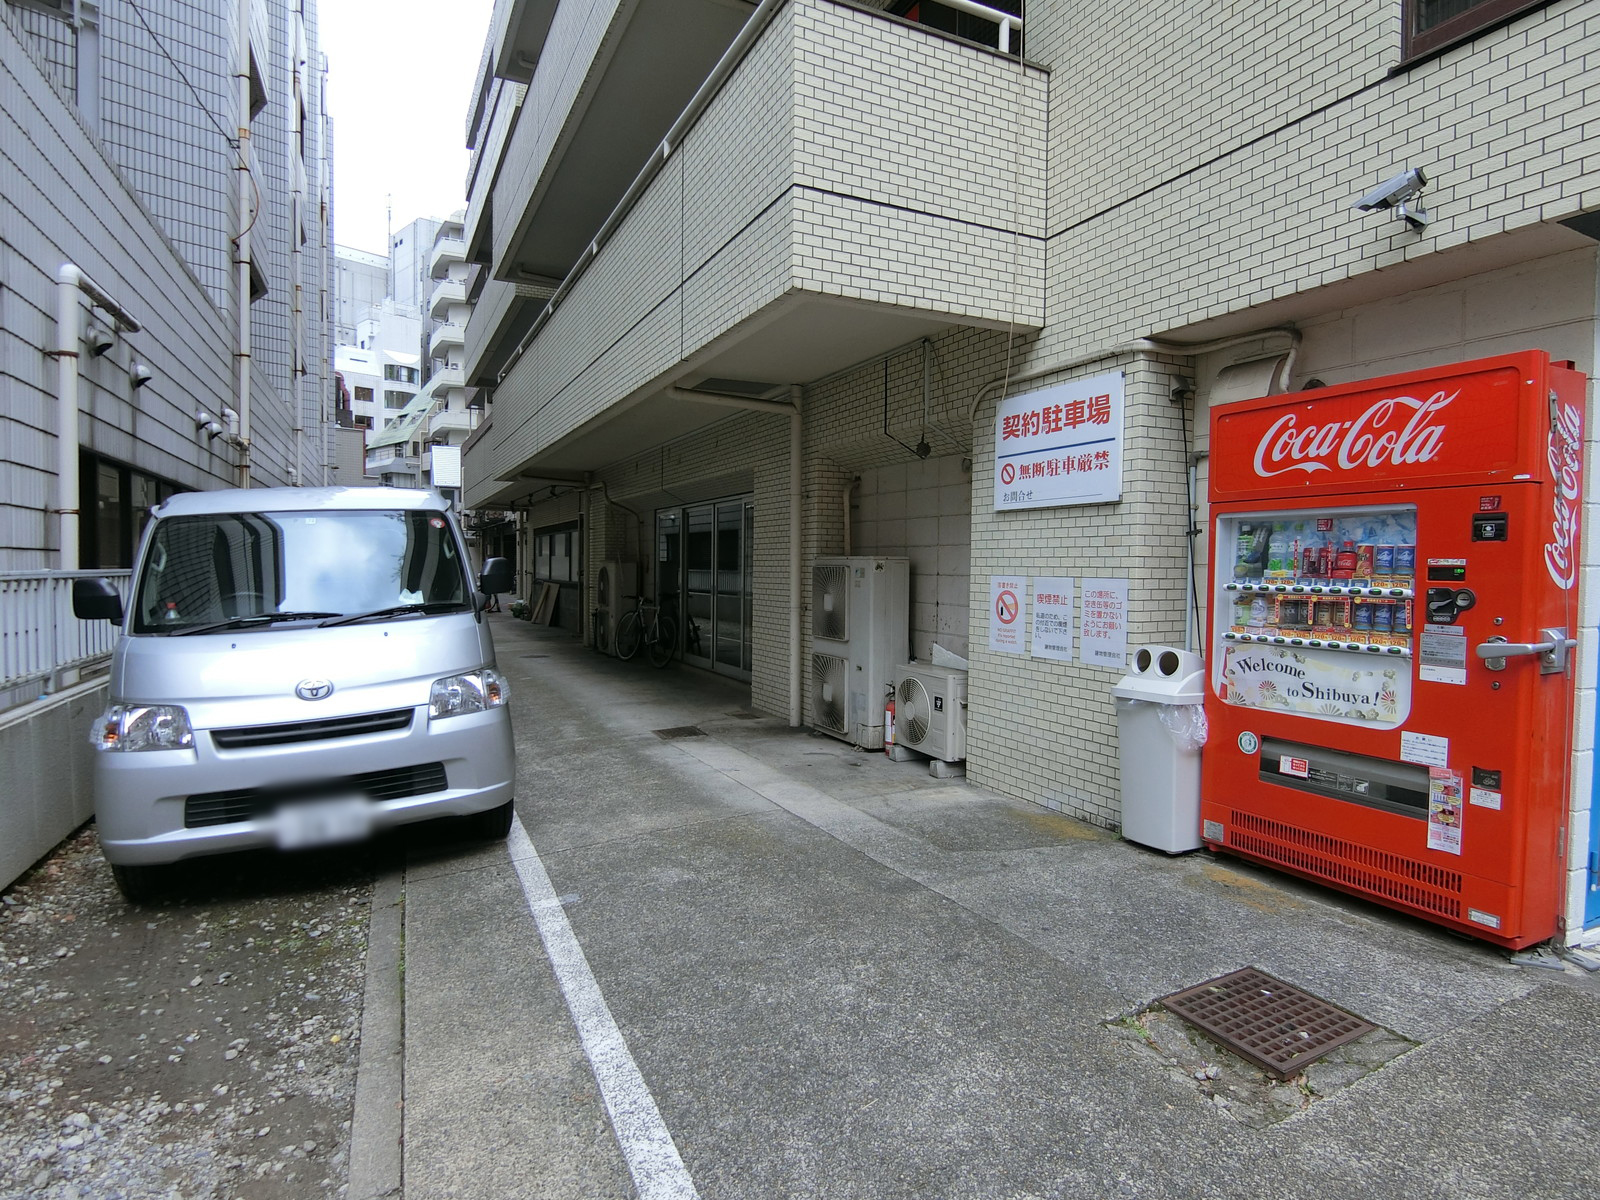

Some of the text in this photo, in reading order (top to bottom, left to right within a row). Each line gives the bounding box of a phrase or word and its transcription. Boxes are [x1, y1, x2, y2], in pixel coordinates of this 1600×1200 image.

[1002, 394, 1111, 441] 契約駐車場
[1253, 388, 1462, 477] Coca-Cola
[1018, 450, 1110, 481] 無断駐車厳禁
[1003, 490, 1033, 502] お問合せ
[1036, 593, 1068, 606] 喫煙禁止
[1084, 590, 1119, 600] この場所に、
[1084, 600, 1122, 610] 空き缶等のゴ
[1084, 610, 1122, 620] ミを置かない
[1083, 620, 1122, 630] ようにお願い
[1083, 629, 1111, 639] 致します。
[1237, 657, 1306, 680] Welcome
[1287, 686, 1299, 698] to
